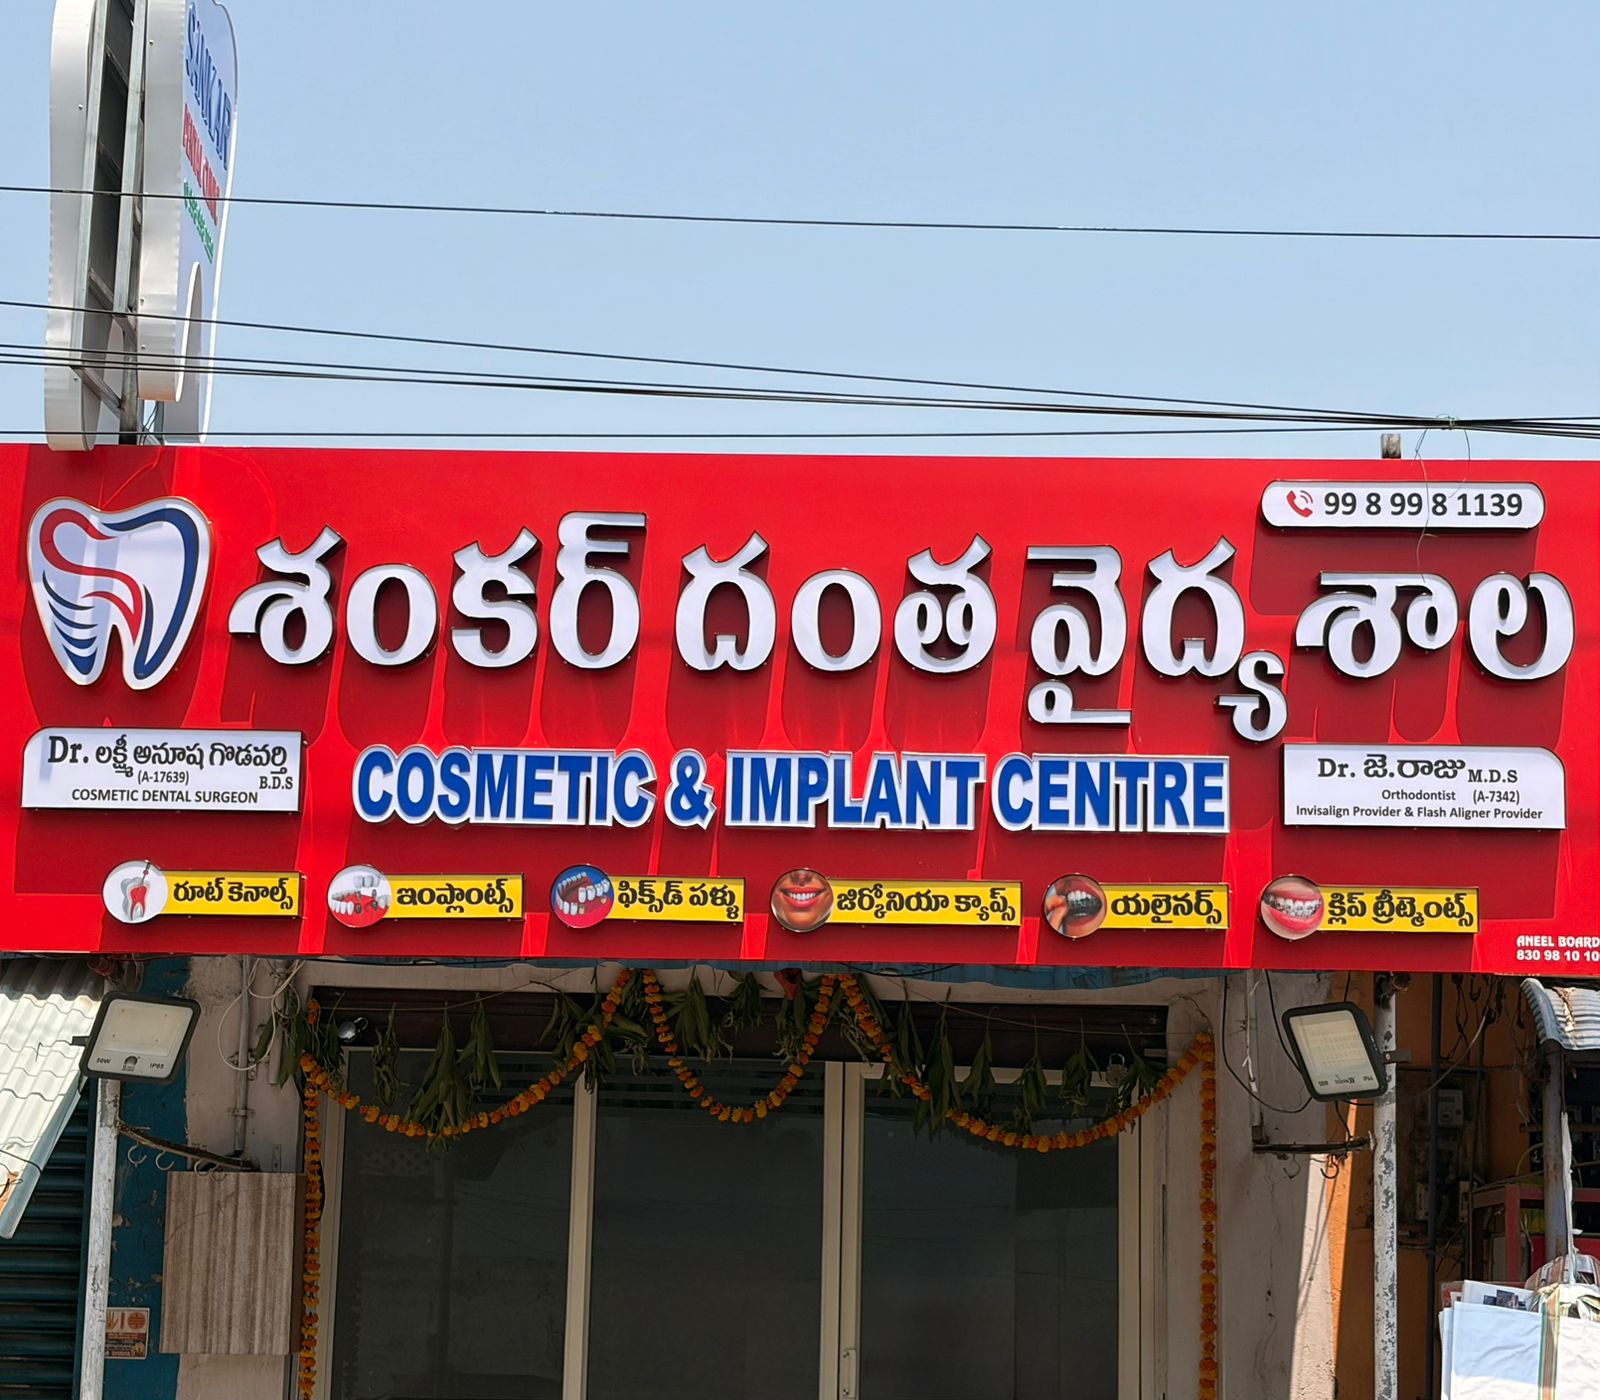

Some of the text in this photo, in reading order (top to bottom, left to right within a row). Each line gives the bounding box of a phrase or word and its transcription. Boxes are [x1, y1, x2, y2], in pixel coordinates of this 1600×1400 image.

[186, 2, 231, 170] SANKAR
[1325, 493, 1522, 516] 99 8 99 8 1139
[229, 513, 1573, 741] శంకర్ దంత వైద్య శాల
[48, 736, 88, 763] Dr.
[96, 735, 133, 777] లక్ష్మీ
[134, 743, 203, 769] అనూష
[138, 771, 188, 785] (A-17639)
[1318, 759, 1355, 777] Dr.
[1469, 770, 1517, 782] M.D.S
[260, 777, 292, 789] B.D.S
[359, 751, 1224, 826] COSMETIC & IMPLANT CENTRE
[72, 789, 257, 803] COSMETIC DENTAL SURGEON
[1382, 790, 1519, 804] Orthodontist (A-7342)
[1297, 806, 1542, 819] Invisalign Provider & Flash Aligner Provider
[174, 877, 293, 909] రూట్ కెనాల్స్
[397, 878, 513, 913] ఇంప్లాంట్స్
[837, 883, 1015, 921] జిర్కోనియా క్యాప్స్
[1111, 890, 1221, 924] యలైనర్స్
[1328, 892, 1366, 924] క్లిప్
[1517, 936, 1600, 948] ANEEL BOARD
[1517, 950, 1600, 961] 830 98 10 10
